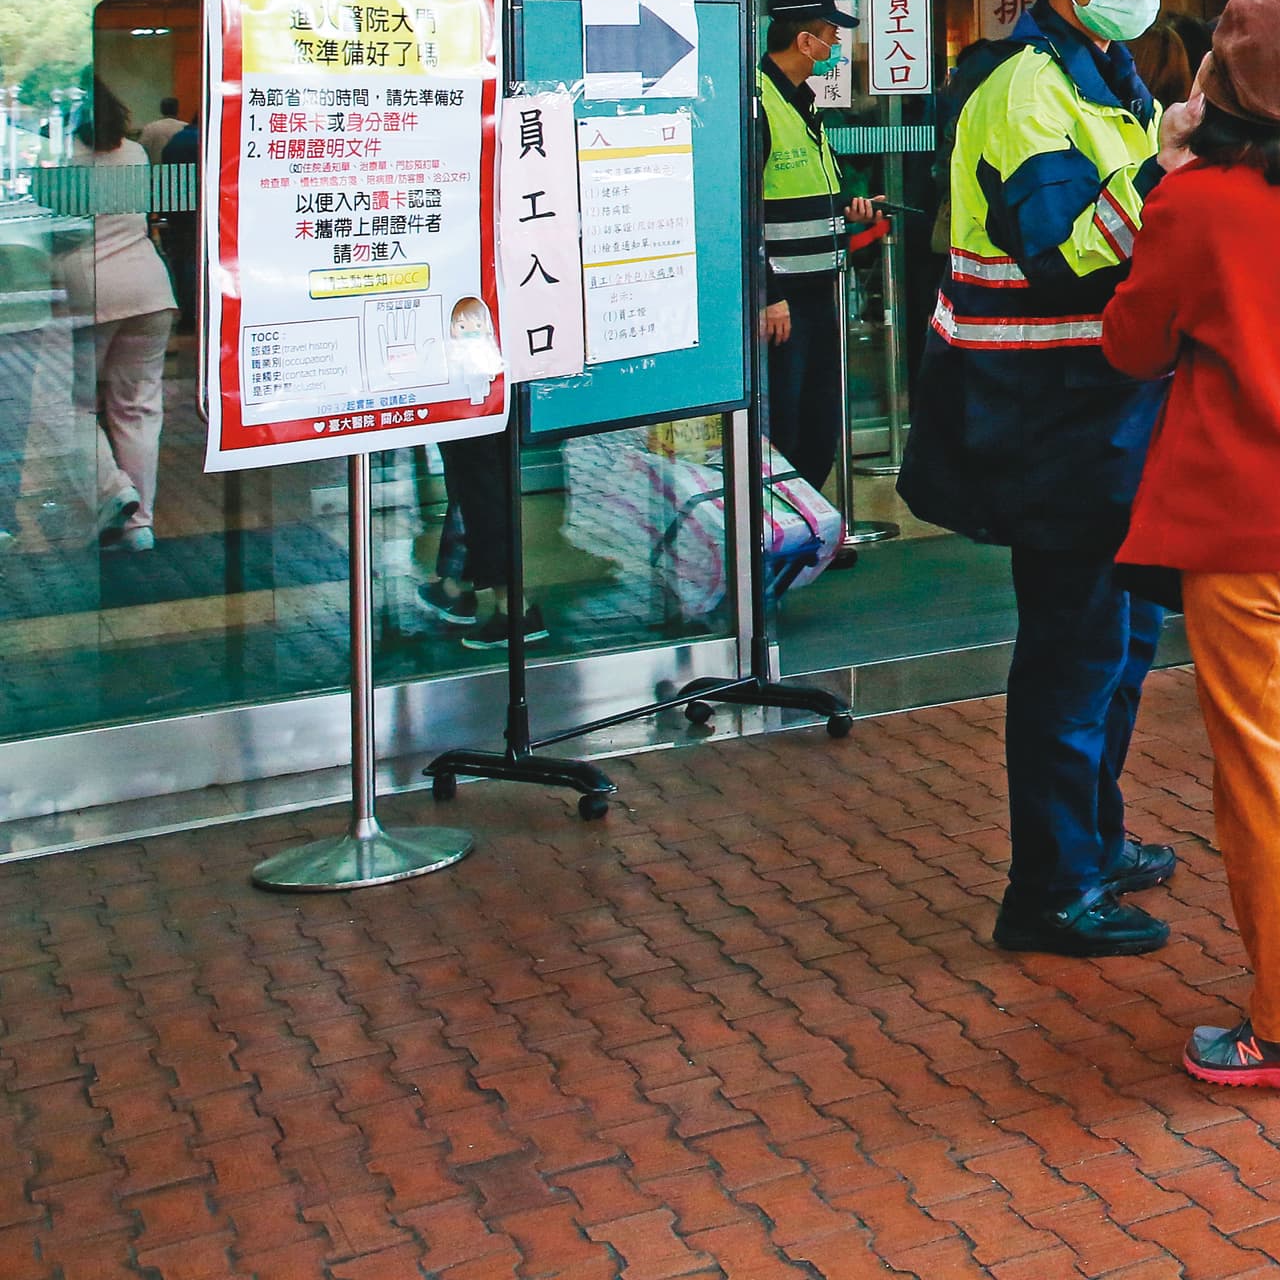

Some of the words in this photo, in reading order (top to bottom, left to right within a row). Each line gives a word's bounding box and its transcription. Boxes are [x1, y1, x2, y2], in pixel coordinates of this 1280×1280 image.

[291, 39, 438, 68] 您準備好了嗎
[249, 114, 262, 132] 1.
[268, 111, 419, 133] 健保卡或身分證件
[247, 141, 261, 158] 2.
[267, 137, 382, 159] 相關證明文件
[295, 189, 443, 213] 以便入內讀卡認證
[295, 214, 442, 239] 未攜帶上開證件者
[518, 108, 560, 357] 員工入口
[333, 241, 408, 264] 請勿進入
[328, 415, 376, 432] 臺大醫院
